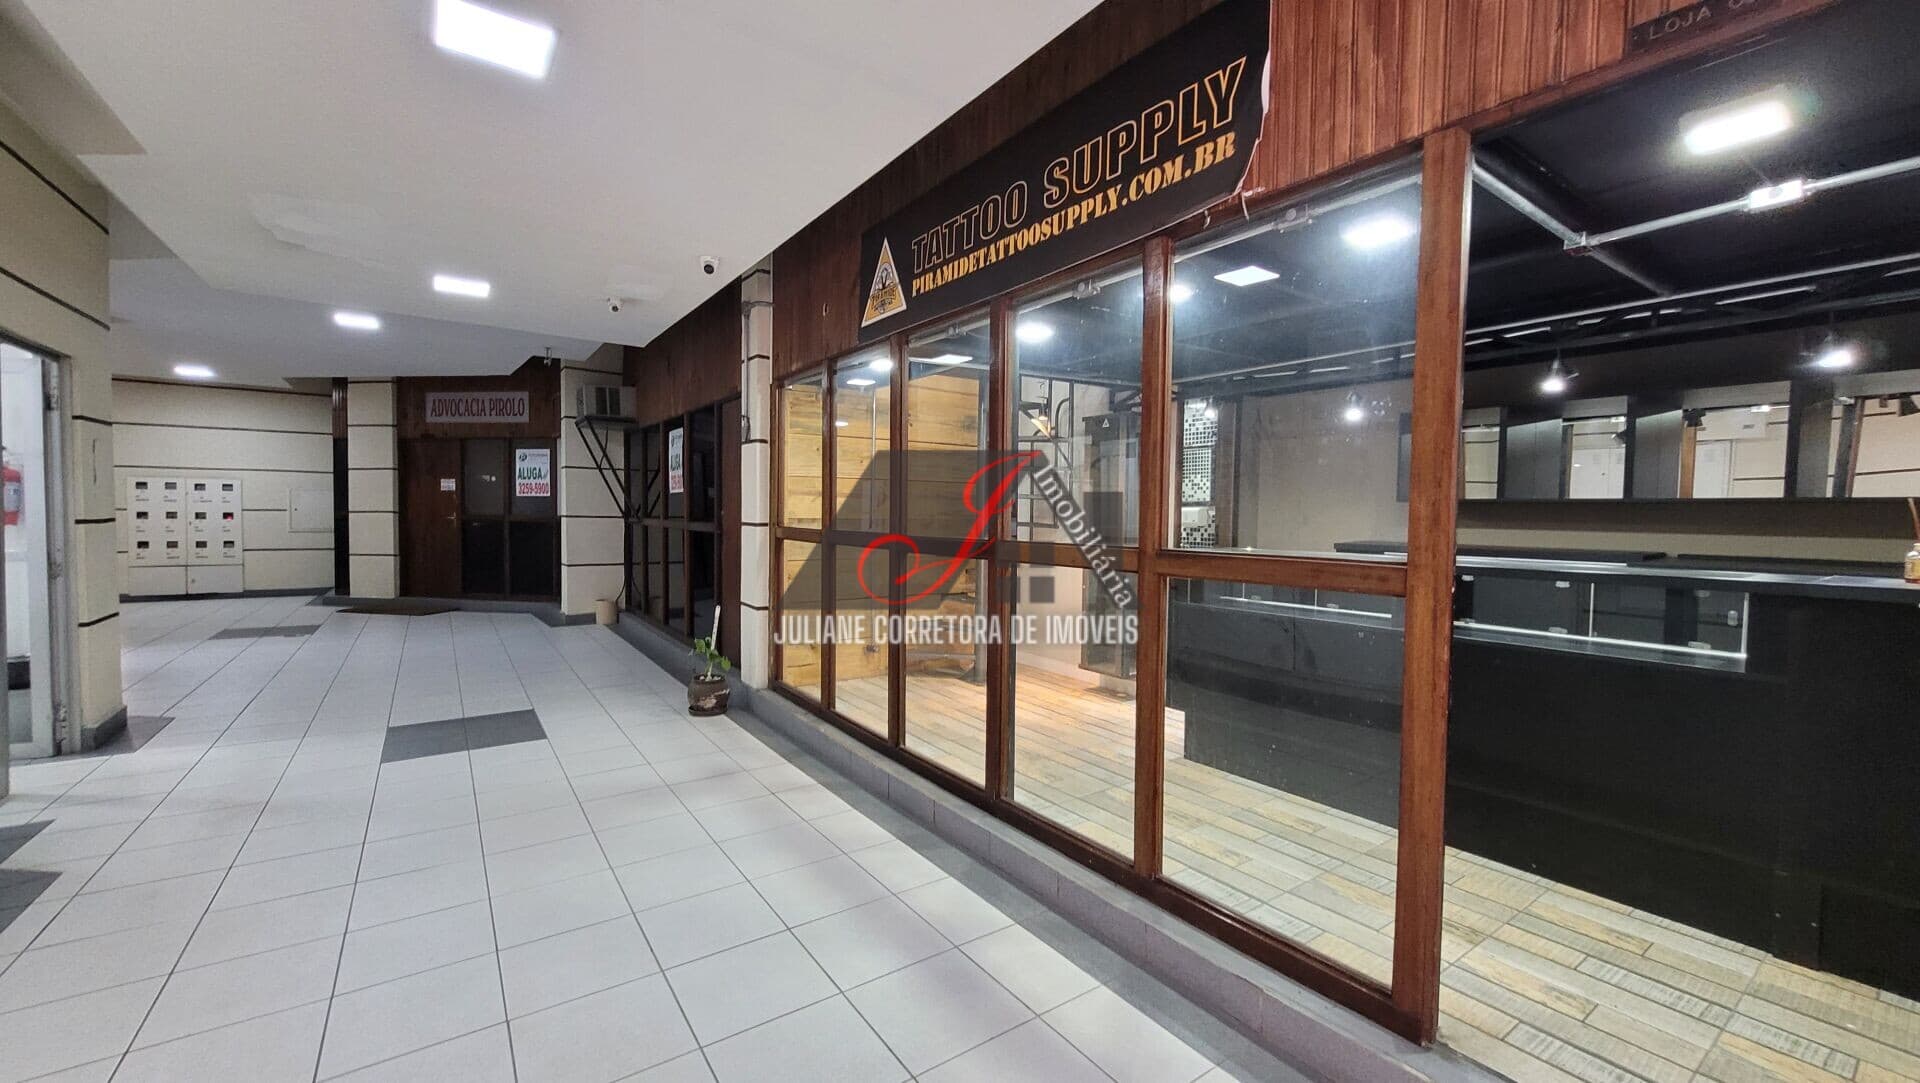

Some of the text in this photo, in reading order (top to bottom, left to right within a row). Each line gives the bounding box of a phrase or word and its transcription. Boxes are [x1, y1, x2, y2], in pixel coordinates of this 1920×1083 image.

[1649, 5, 1712, 39] LOJA
[911, 55, 1247, 273] TATTOO SUPPLY
[911, 131, 1237, 298] PIRAMIDETATTOOSUPPLY.COM.BR
[430, 398, 525, 417] ADVOCACIA PIROLO
[517, 466, 543, 480] ALUGA
